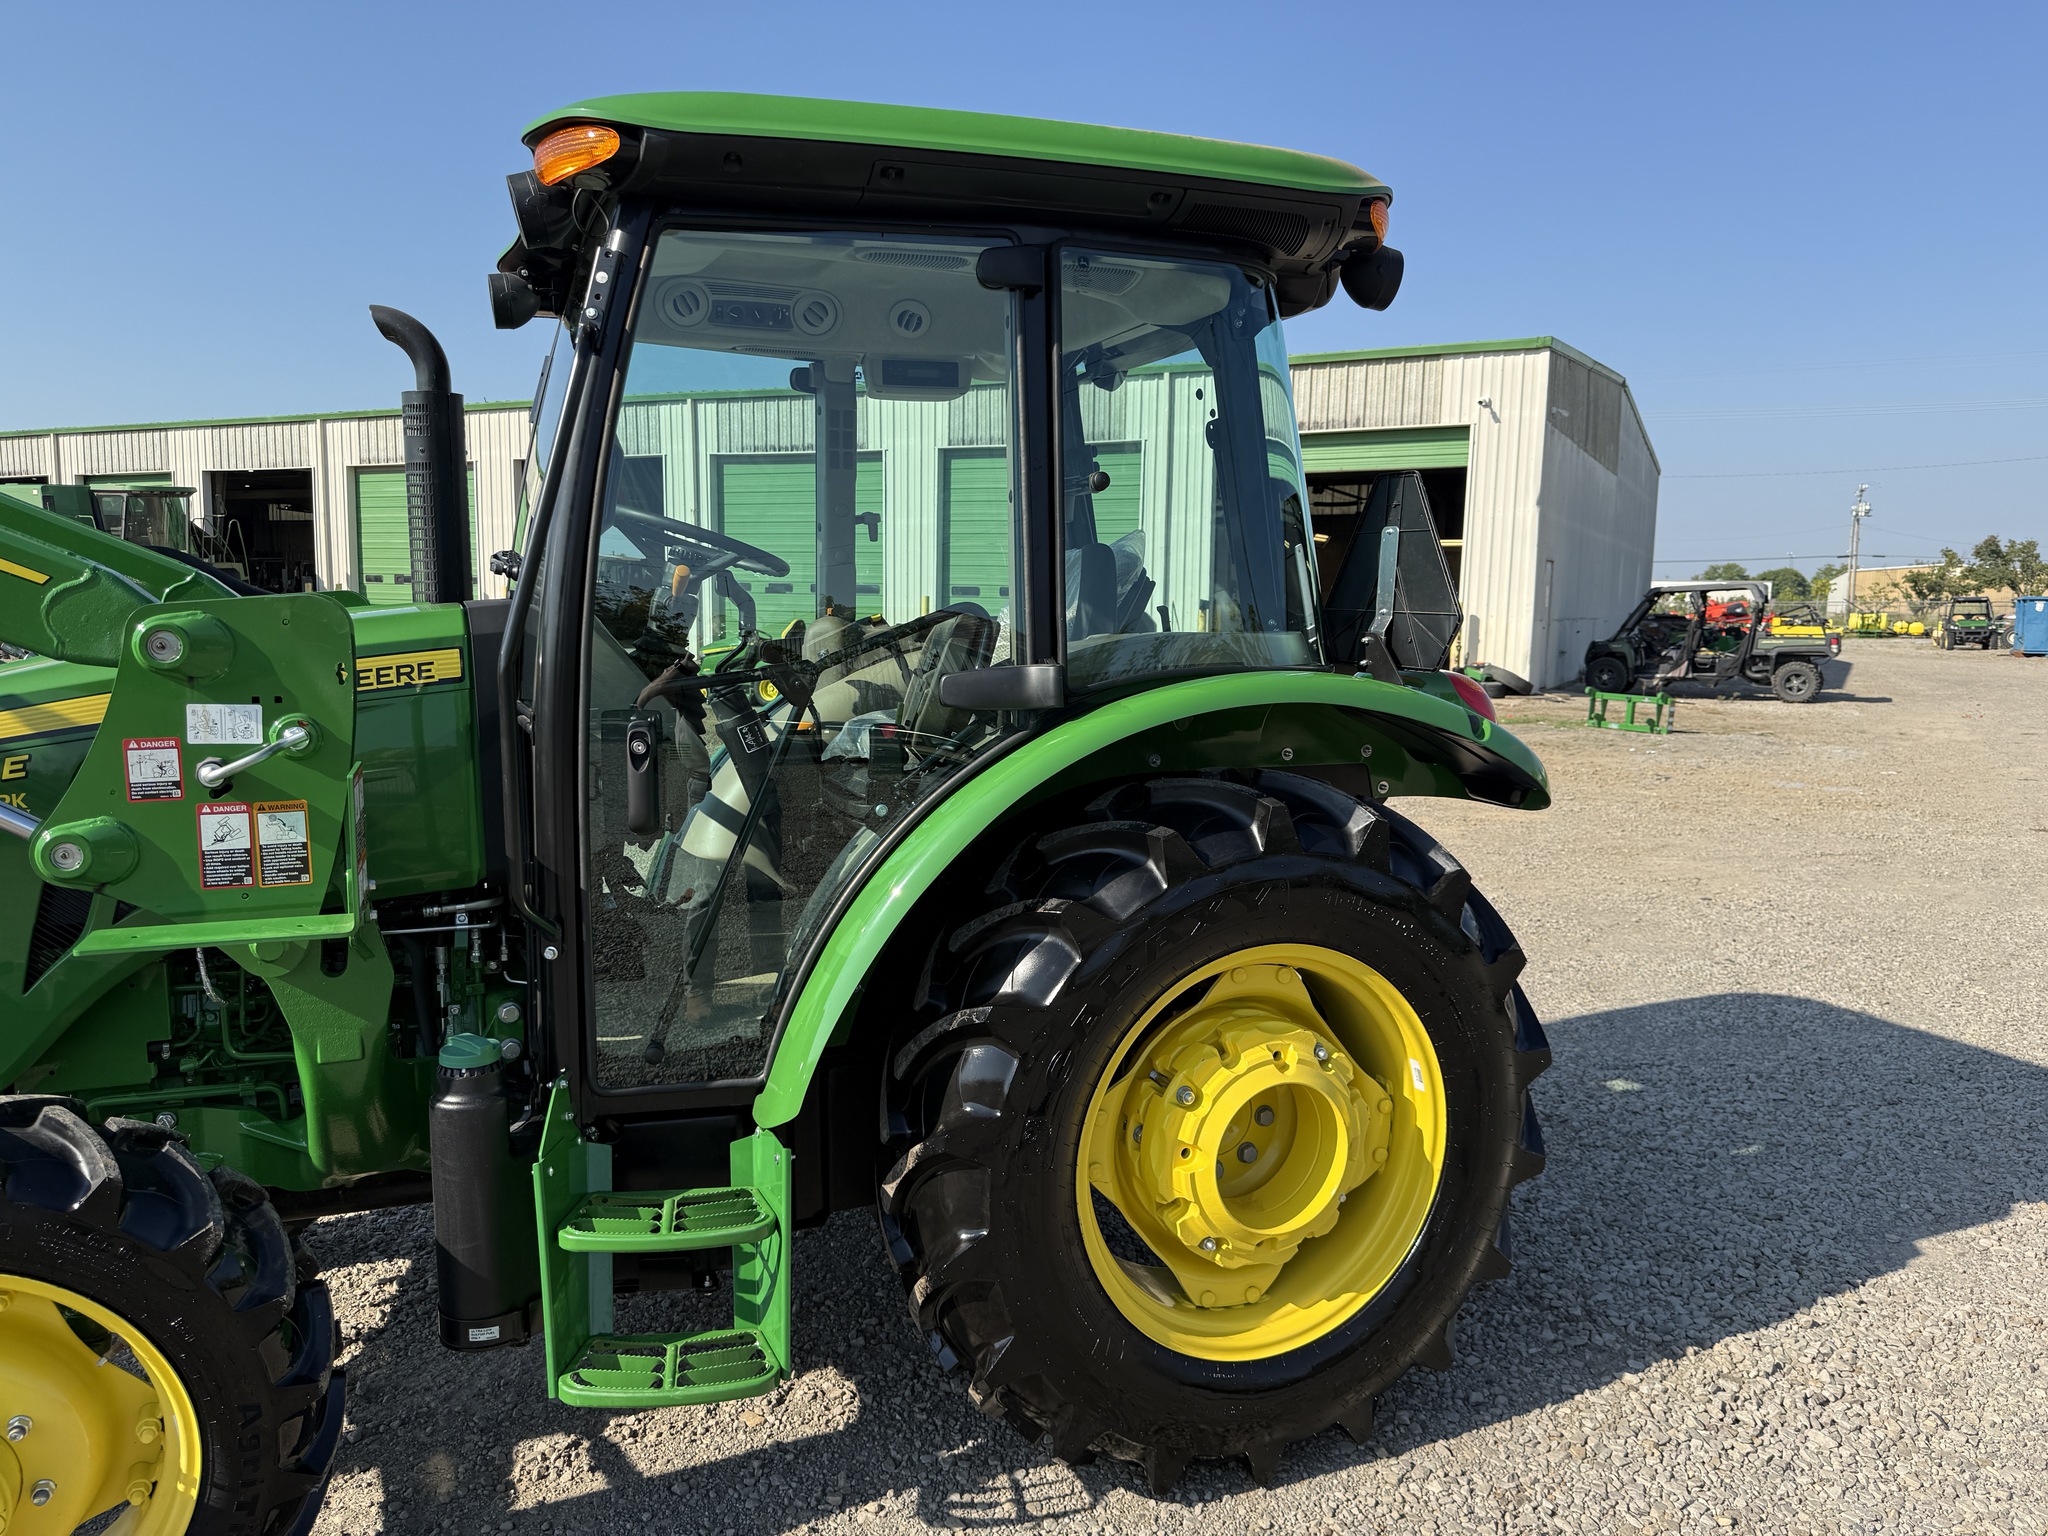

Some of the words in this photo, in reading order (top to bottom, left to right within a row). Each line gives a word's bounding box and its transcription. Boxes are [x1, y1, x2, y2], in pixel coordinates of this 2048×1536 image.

[140, 740, 176, 748] DANGER
[213, 804, 247, 813] DANGER
[267, 803, 305, 811] WARNING
